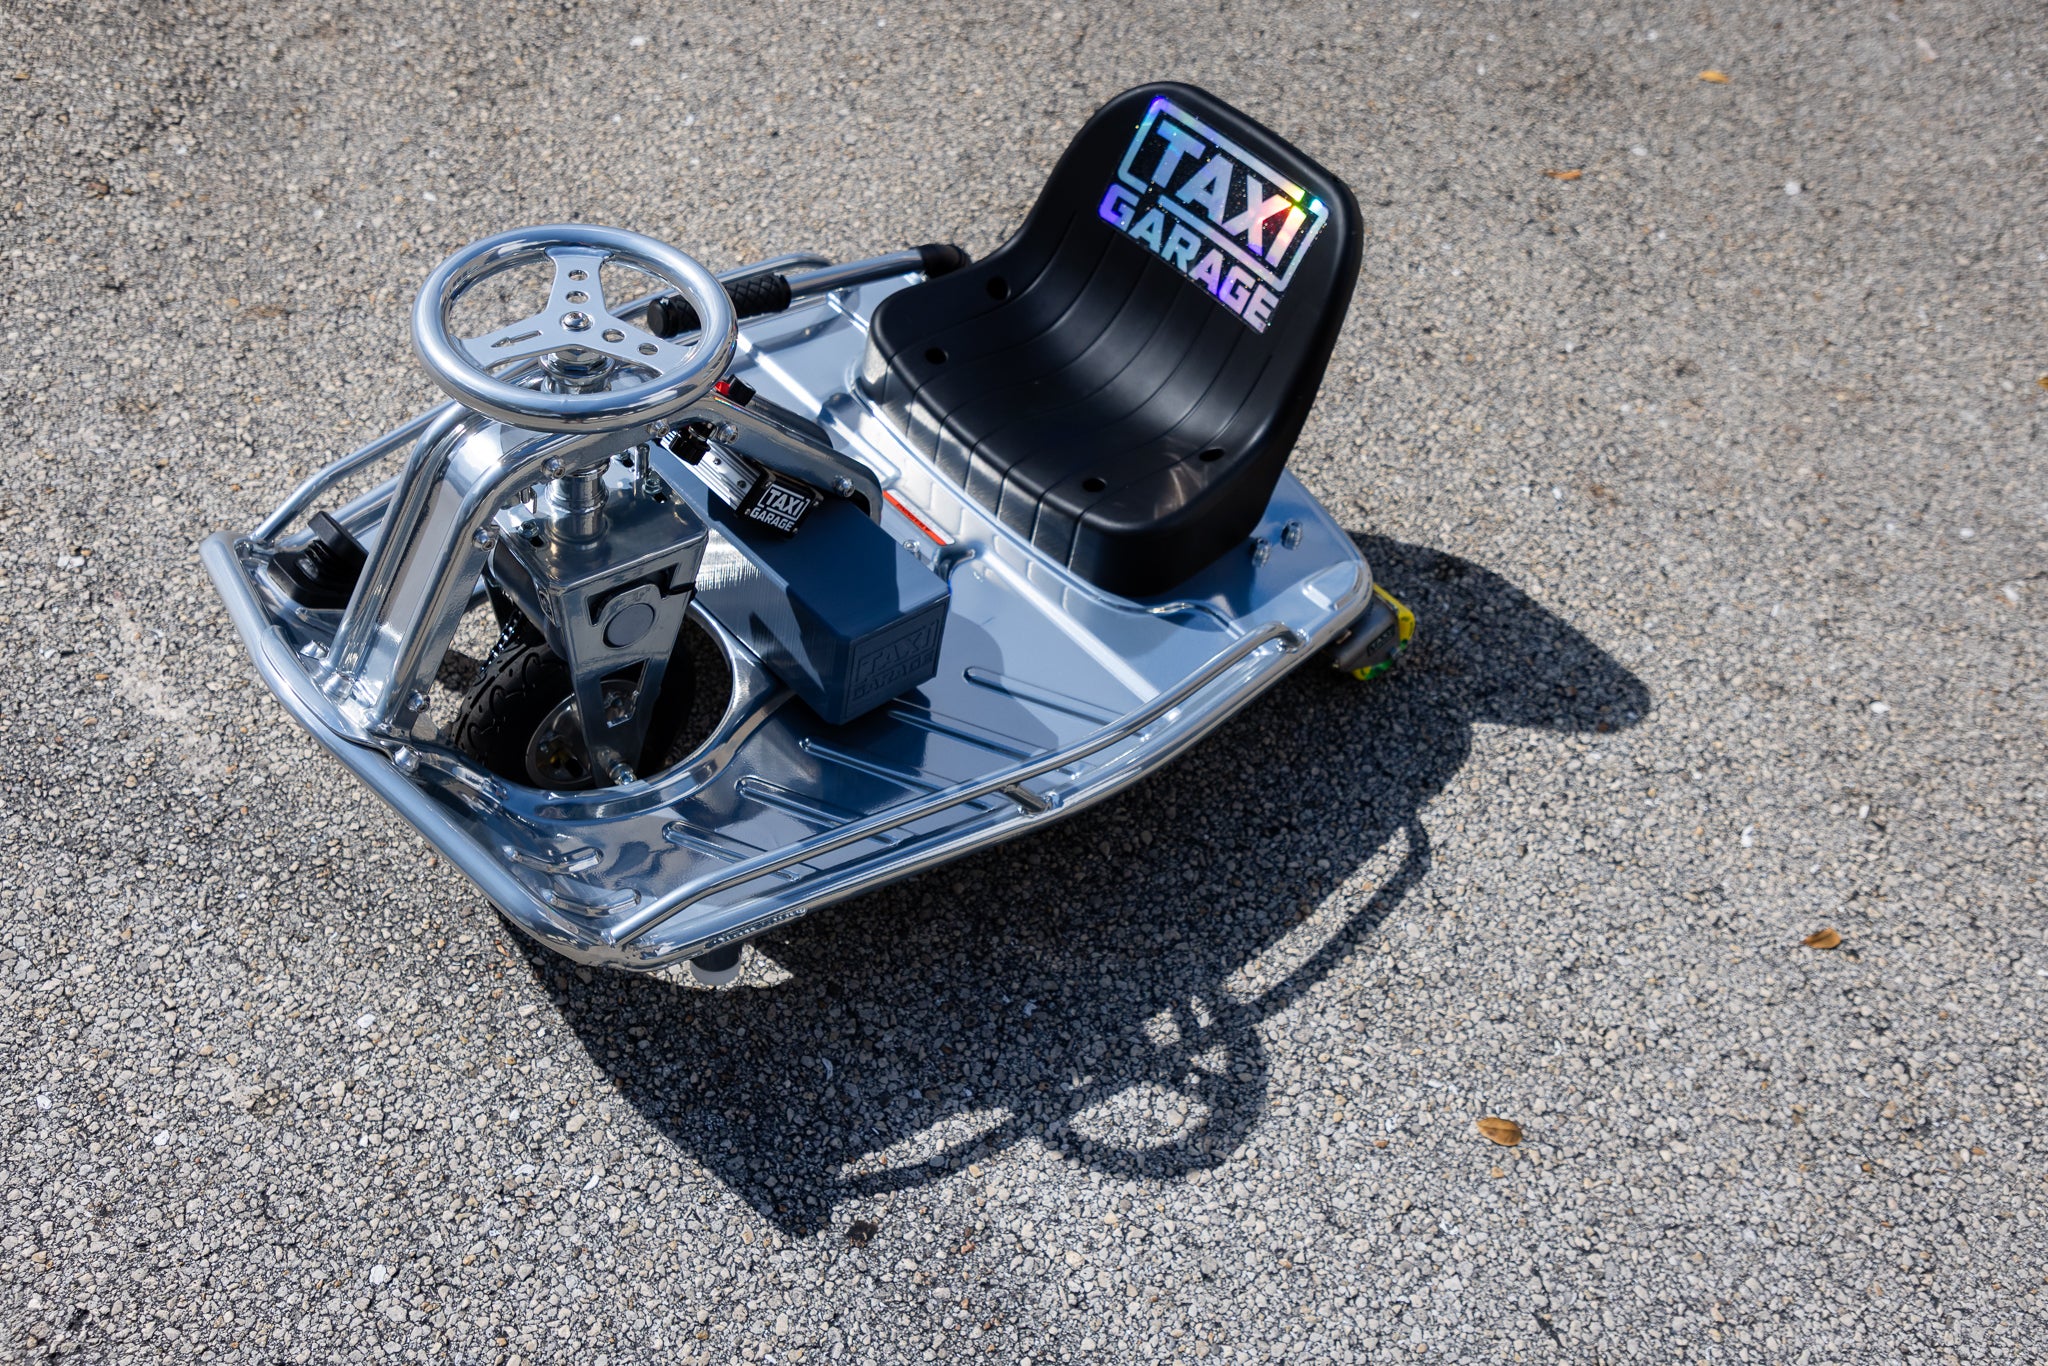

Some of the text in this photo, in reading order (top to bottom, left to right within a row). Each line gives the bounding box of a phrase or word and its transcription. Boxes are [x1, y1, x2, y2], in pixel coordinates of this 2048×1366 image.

[1151, 119, 1306, 268] TAXI
[1098, 182, 1280, 333] GARAGE
[750, 509, 796, 532] GARAGE
[765, 490, 805, 516] TAXI
